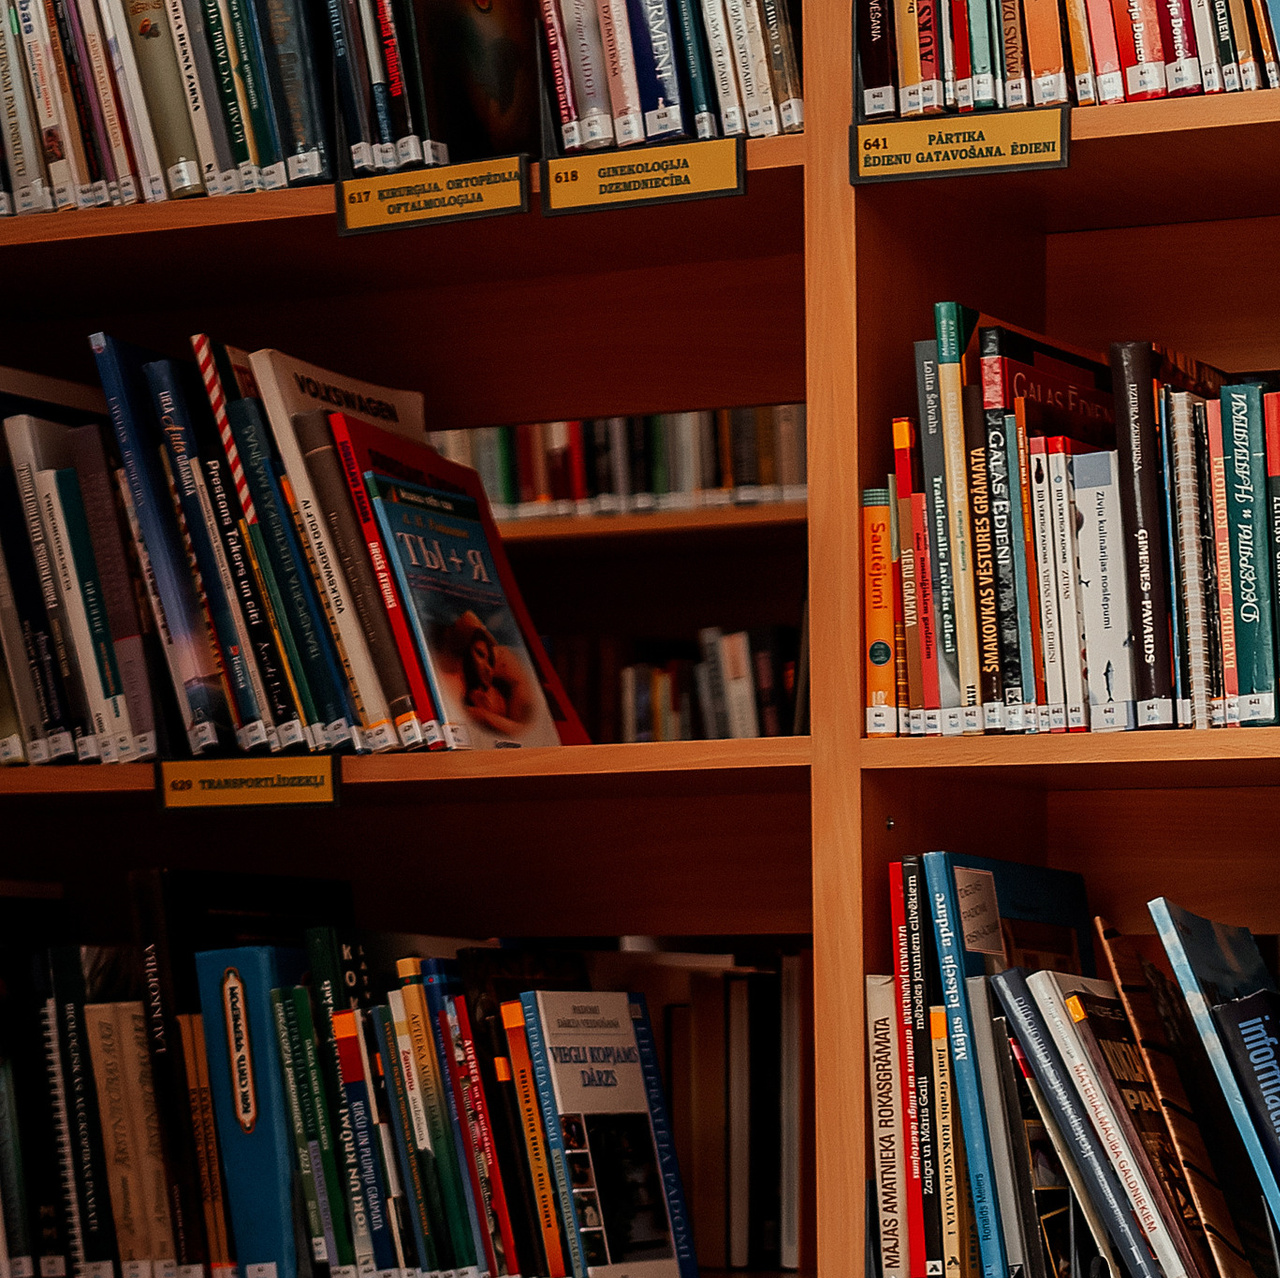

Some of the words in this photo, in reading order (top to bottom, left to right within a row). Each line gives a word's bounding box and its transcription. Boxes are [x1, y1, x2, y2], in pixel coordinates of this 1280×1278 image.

[863, 137, 888, 150] 641
[928, 130, 986, 146] PĀRTIKA
[864, 151, 911, 168] ĒDIENU
[1010, 140, 1056, 157] ĒDIENI
[555, 171, 578, 183] 618
[923, 360, 935, 391] Lolita
[205, 458, 235, 526] Prestons
[967, 447, 989, 515] GRĀMATA
[1036, 489, 1045, 502] 101
[1055, 488, 1063, 501] 101
[1213, 456, 1228, 527] КОМПОТЫ
[225, 527, 249, 577] Takers
[314, 540, 346, 614] VOLKSWAGEN
[867, 522, 889, 610] Sautējumi
[900, 548, 915, 579] SIERU
[972, 517, 993, 585] VĒSTURES
[239, 579, 253, 597] un
[244, 599, 263, 625] citi
[976, 588, 999, 673] ŠMAKOVKAS
[1140, 600, 1155, 663] PAVARDS
[930, 891, 953, 947] apdare
[940, 954, 963, 1008] iekšējā
[949, 1015, 970, 1061] Mājas
[871, 1016, 894, 1128] ROKASGRĀMATA
[879, 1133, 898, 1214] AMATNIEKA
[922, 1144, 931, 1157] un
[1117, 1158, 1159, 1233] GALDNIEKIEM
[882, 1217, 900, 1268] MĀJAS
